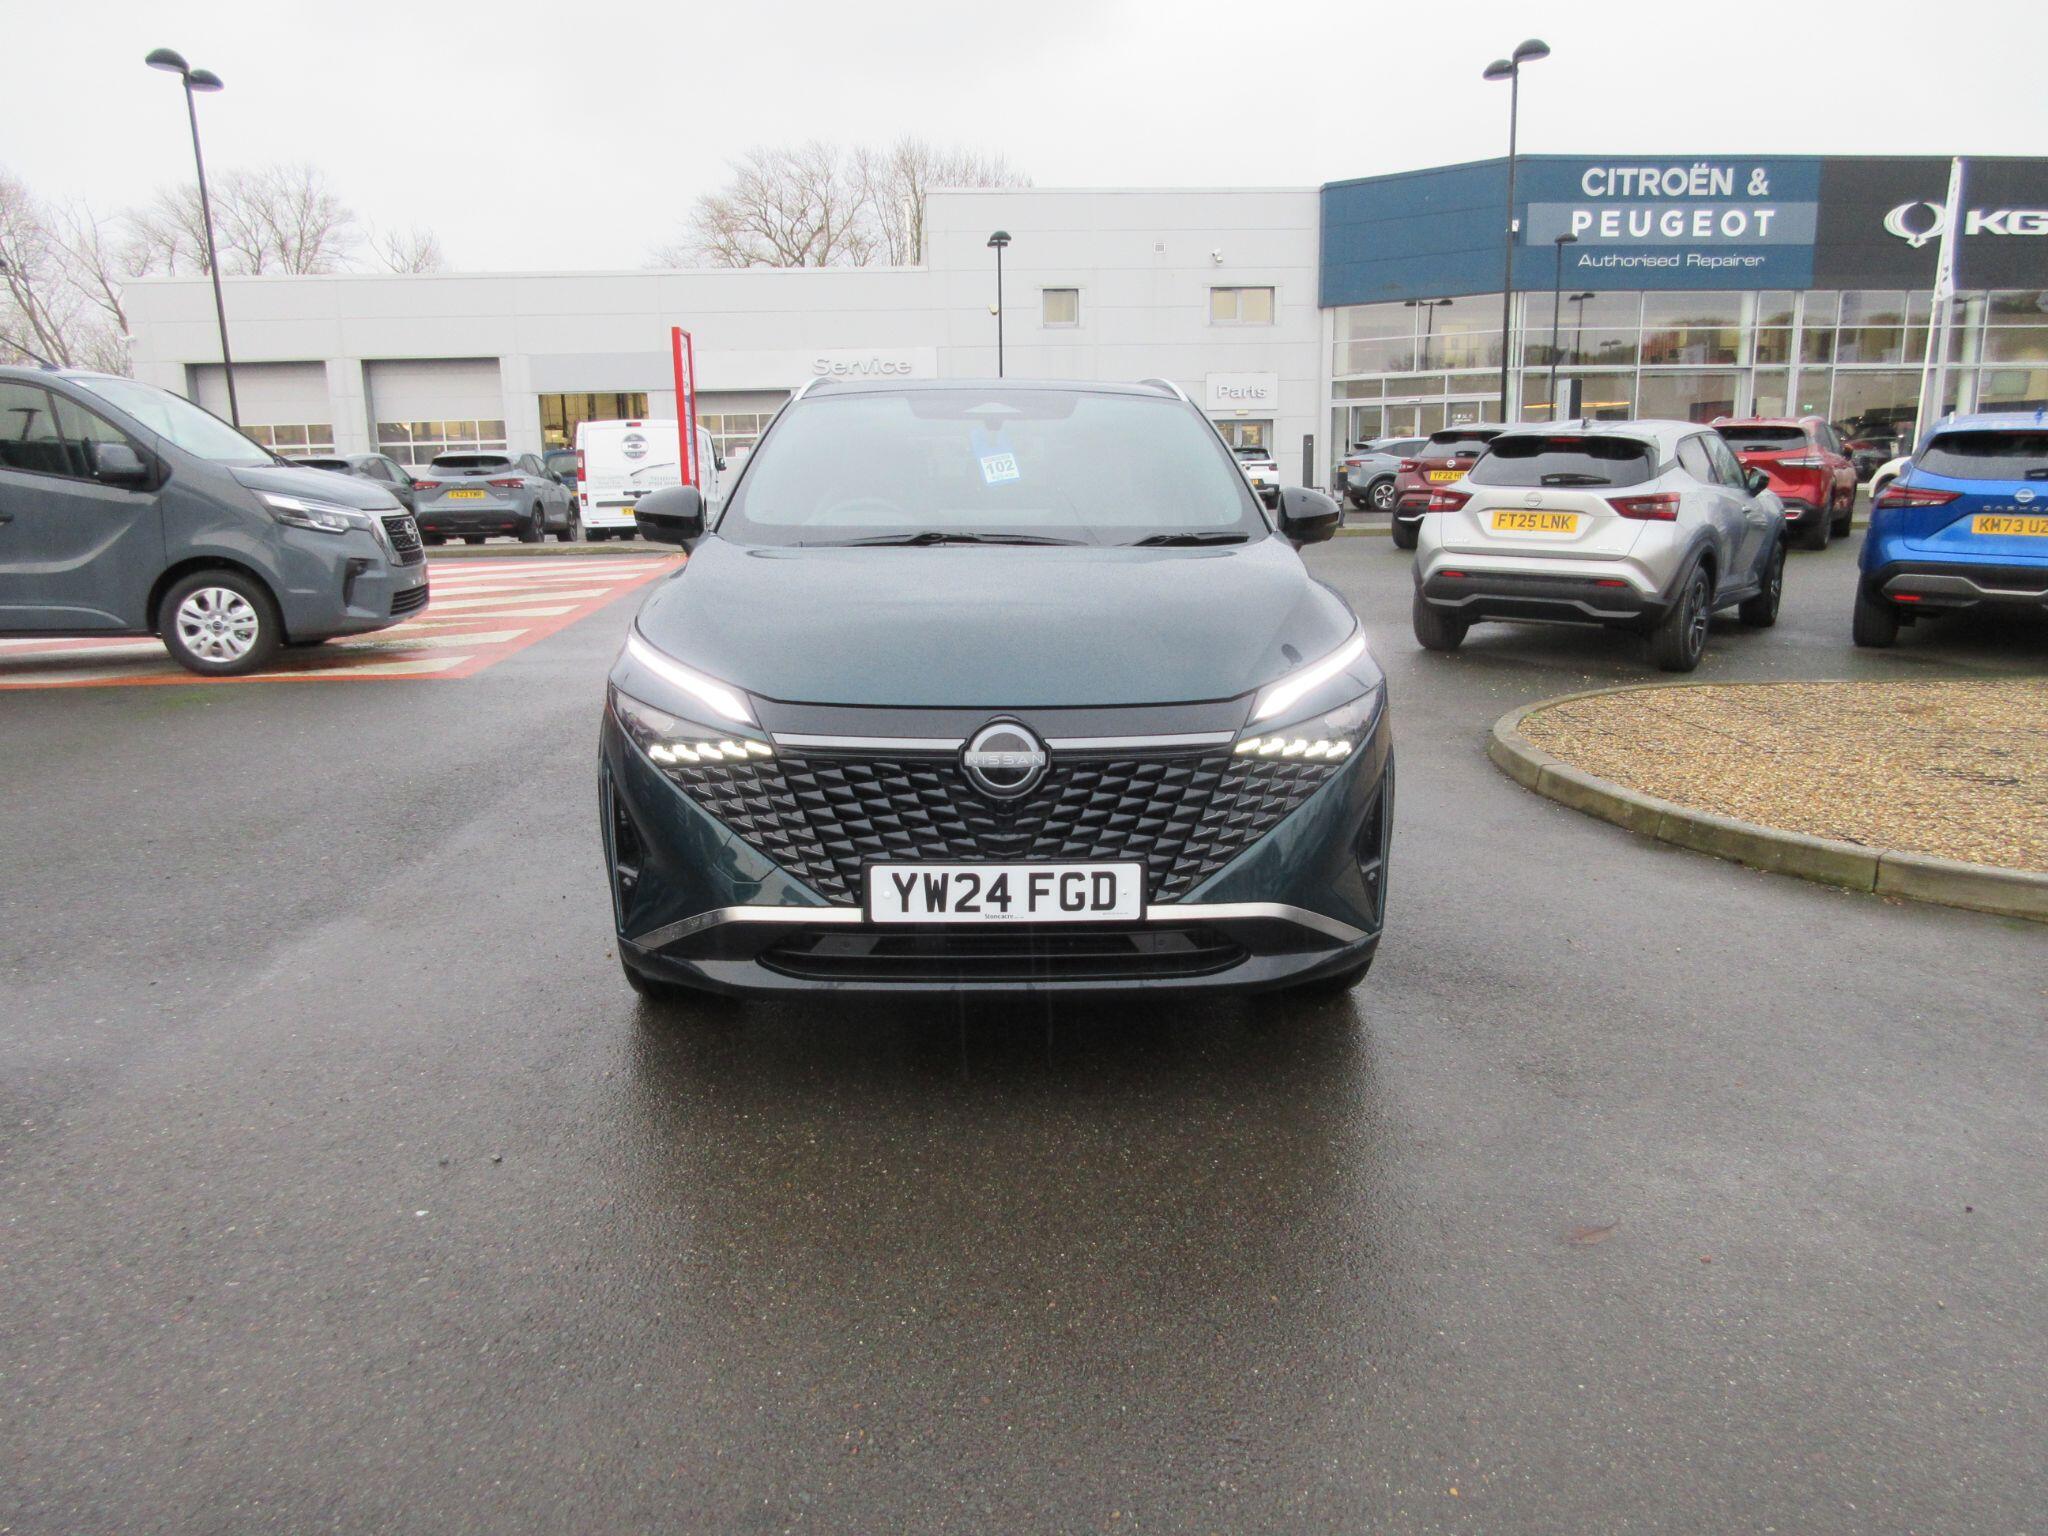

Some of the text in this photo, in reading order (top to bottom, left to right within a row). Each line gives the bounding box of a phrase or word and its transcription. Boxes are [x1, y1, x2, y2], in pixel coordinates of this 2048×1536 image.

[1581, 163, 1769, 196] CITROËN &
[1571, 210, 1775, 237] PEUGEOT
[1578, 254, 1765, 269] Authorised Repairer
[813, 356, 912, 376] Service
[1216, 384, 1268, 400] Parts
[985, 459, 1016, 475] 102
[1497, 511, 1571, 530] FT25 LNK
[966, 754, 1044, 765] NISSAN
[891, 871, 1117, 913] YW24 FGD
